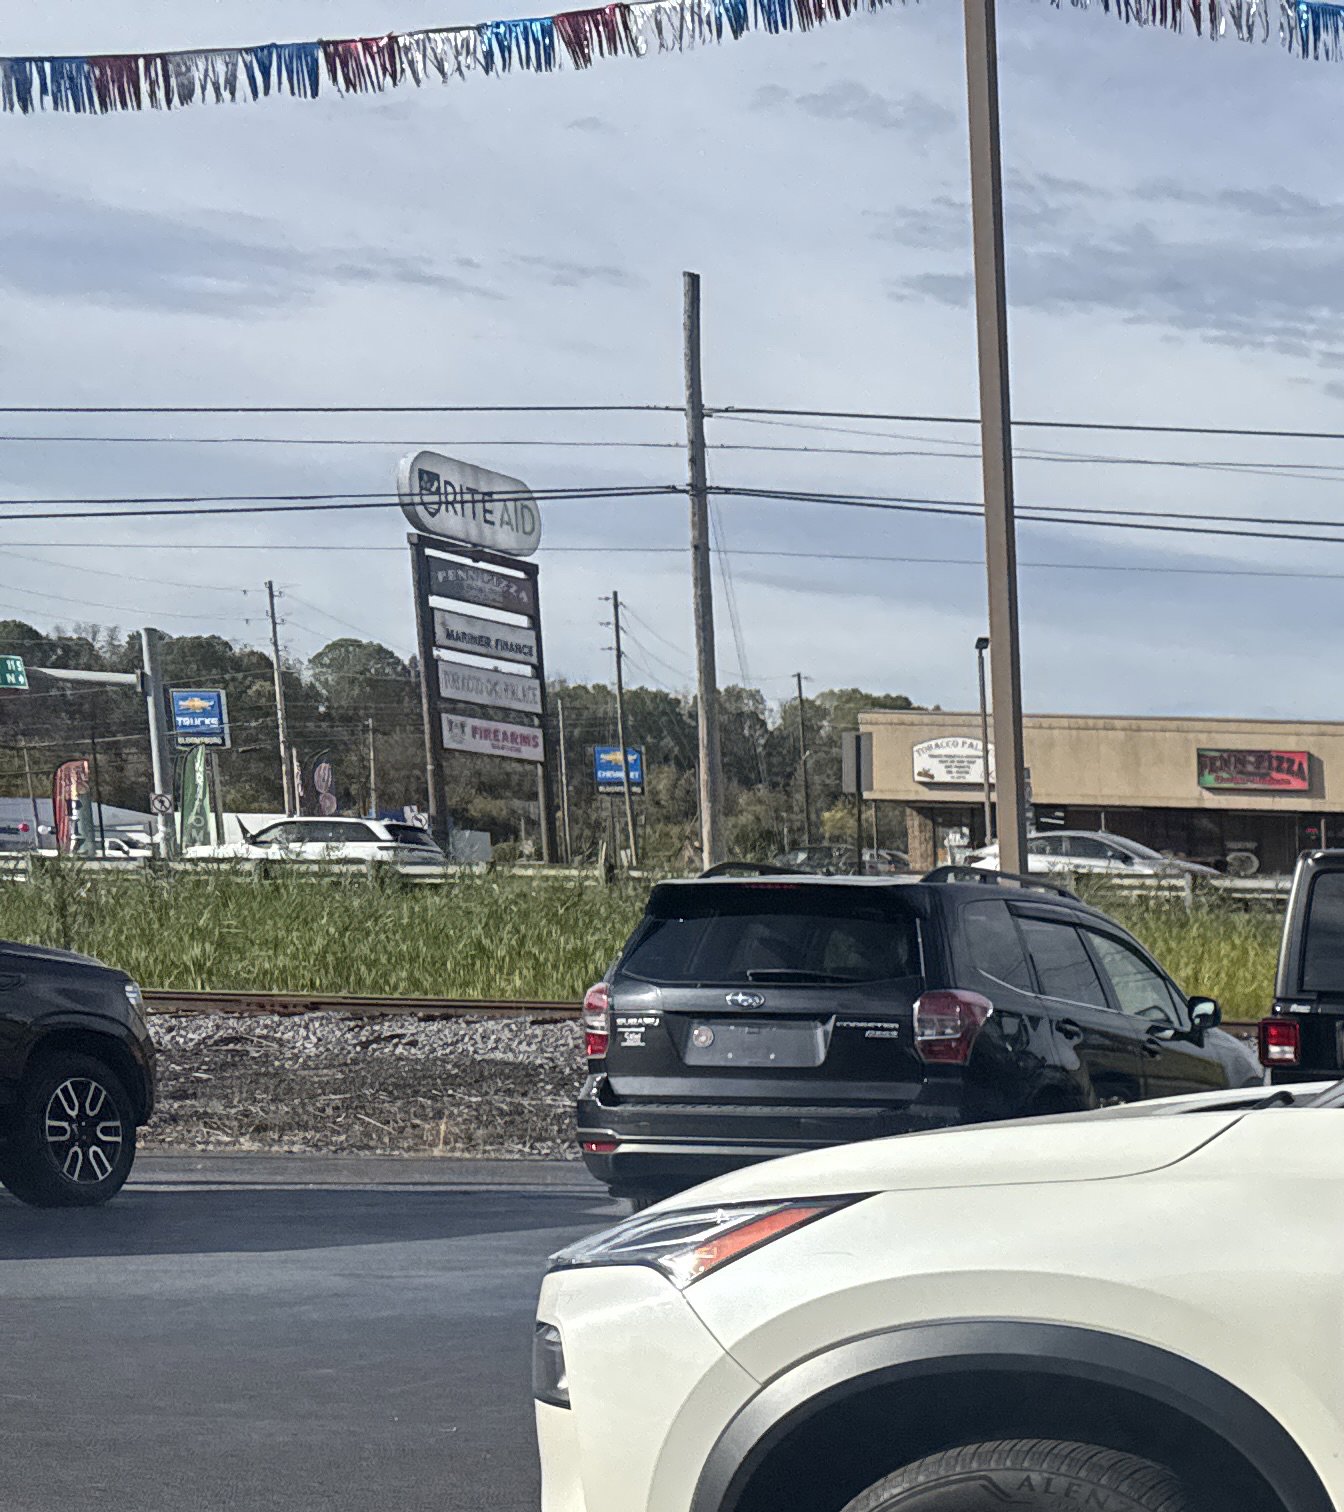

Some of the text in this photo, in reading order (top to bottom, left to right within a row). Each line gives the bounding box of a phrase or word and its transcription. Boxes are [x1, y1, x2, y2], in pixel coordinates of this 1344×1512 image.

[443, 479, 535, 536] RITE AID
[445, 627, 492, 650] MARINER
[176, 716, 219, 727] TRUCKS
[471, 725, 540, 749] FIREARMS
